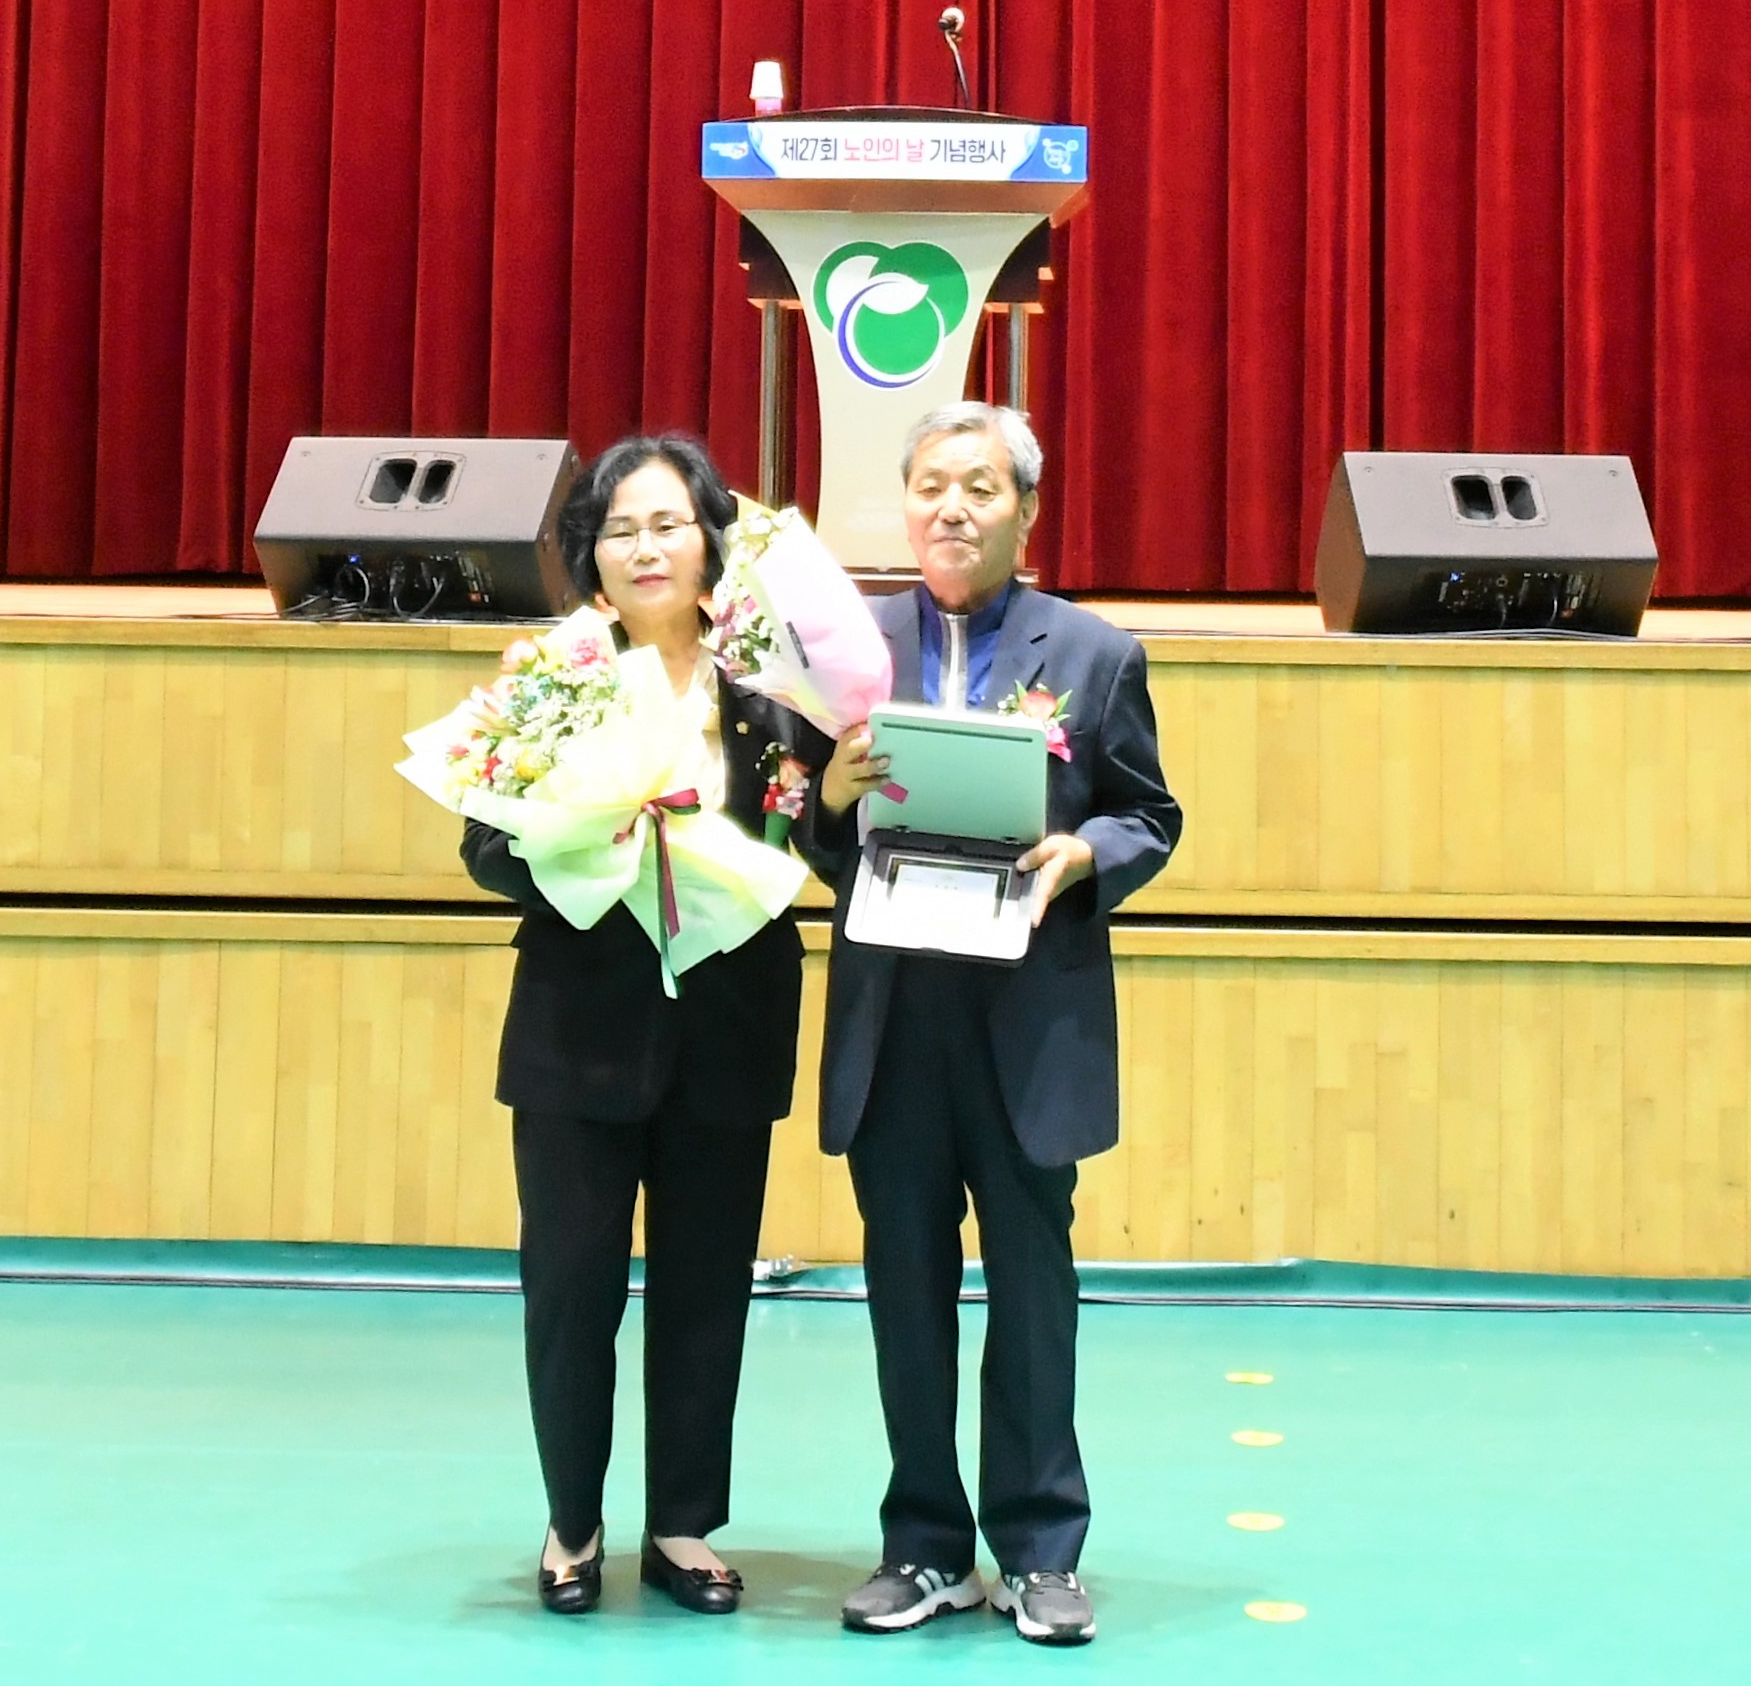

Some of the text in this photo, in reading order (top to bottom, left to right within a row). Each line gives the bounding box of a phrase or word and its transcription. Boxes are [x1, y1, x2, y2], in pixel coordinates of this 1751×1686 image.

[781, 137, 1007, 164] 제27회 노인의 날 기념행사
